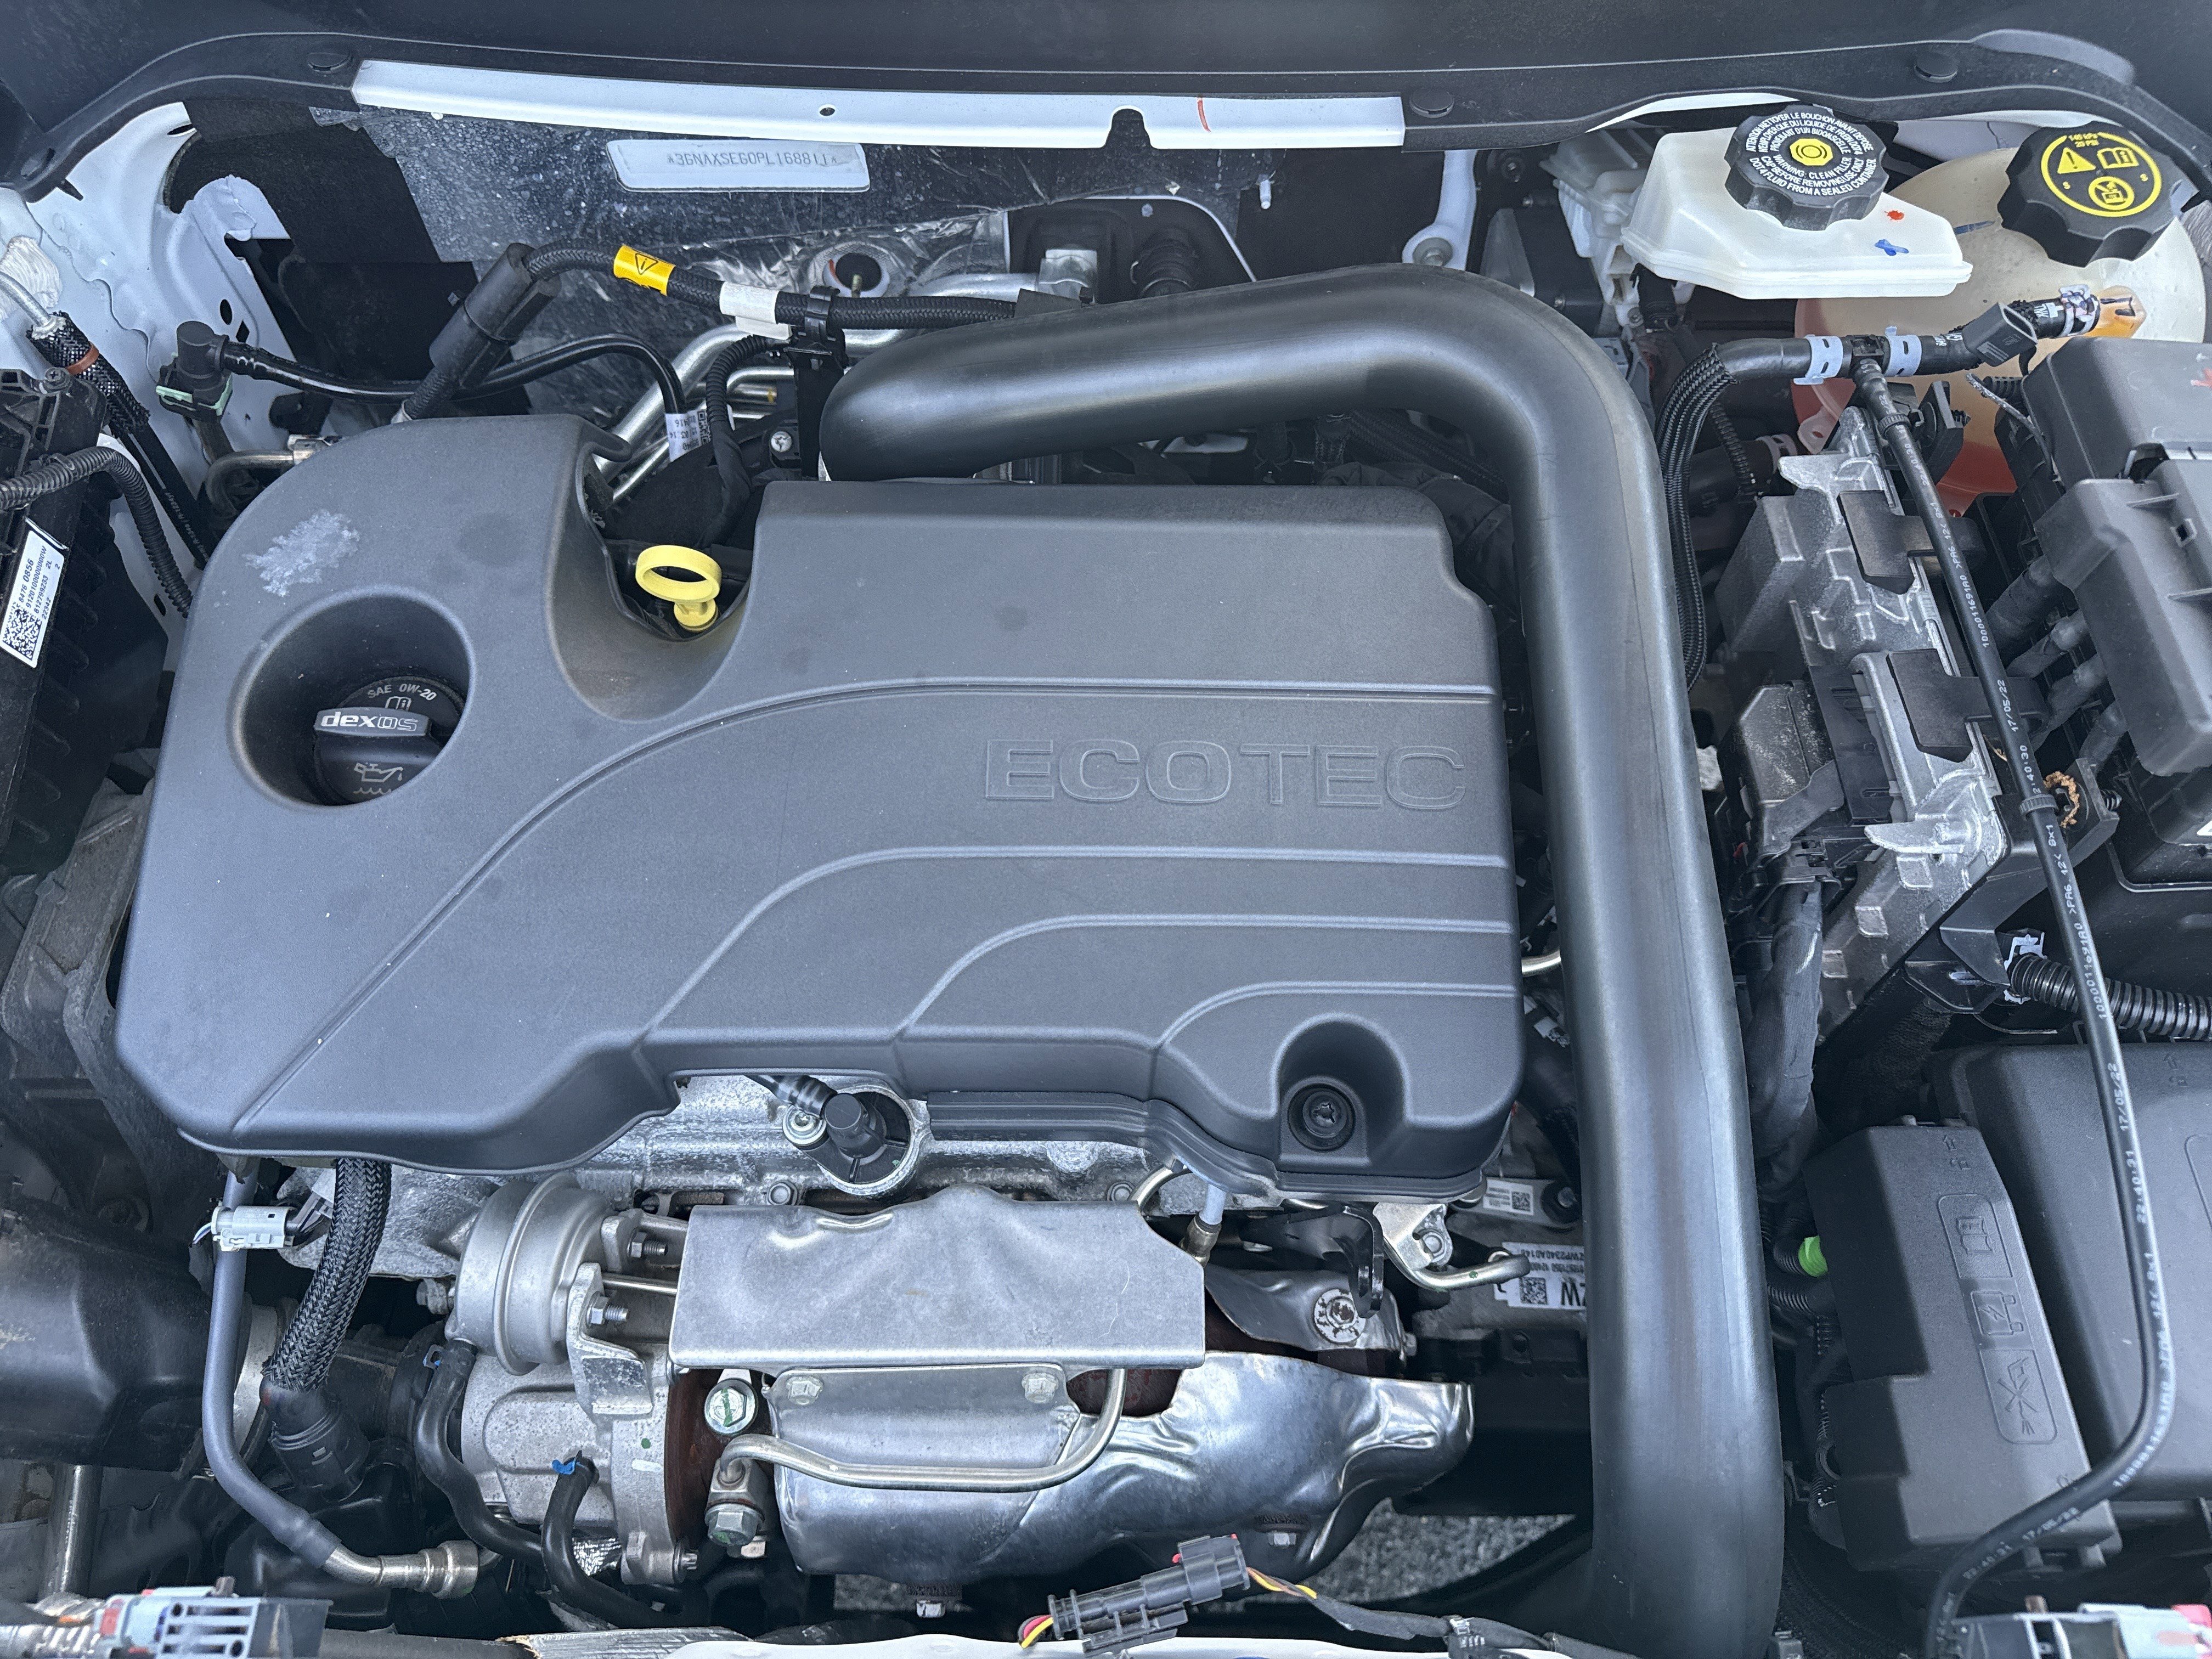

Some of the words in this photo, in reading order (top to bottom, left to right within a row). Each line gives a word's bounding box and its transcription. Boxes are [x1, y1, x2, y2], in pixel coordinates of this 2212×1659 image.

[1758, 113, 1791, 128] NETTOYER
[1801, 112, 1835, 124] BOUCHON
[1833, 120, 1858, 134] AVANT
[1775, 121, 1791, 131] QUE
[1799, 120, 1827, 129] LIQUIDE
[1826, 124, 1837, 132] DE
[1835, 129, 1854, 143] FREIN
[1770, 128, 1796, 151] PROVENANT
[1812, 128, 1834, 140] BIDON
[1761, 156, 1776, 167] CAP
[1771, 166, 1802, 185] BEFORE
[1842, 170, 1858, 182] USE
[1851, 157, 1864, 172] ONLY
[1809, 170, 1837, 179] CLEAN
[1833, 157, 1852, 174] FILLER
[1763, 171, 1787, 187] FLUID
[1786, 182, 1813, 195] FROM
[1821, 184, 1853, 196] SEALED
[22, 558, 34, 583] 0856
[19, 585, 27, 603] 8476
[34, 575, 48, 614] 812799233
[46, 560, 53, 569] 2L
[42, 597, 52, 620] 22342
[368, 684, 392, 698] SAE
[399, 684, 437, 701] 0W-20
[1996, 679, 2019, 733] 17/05/22
[321, 712, 418, 731] dexos
[985, 740, 1465, 809] ECOTEC
[2019, 744, 2042, 794] 2:40:30
[2107, 1063, 2130, 1130] 17/05/22
